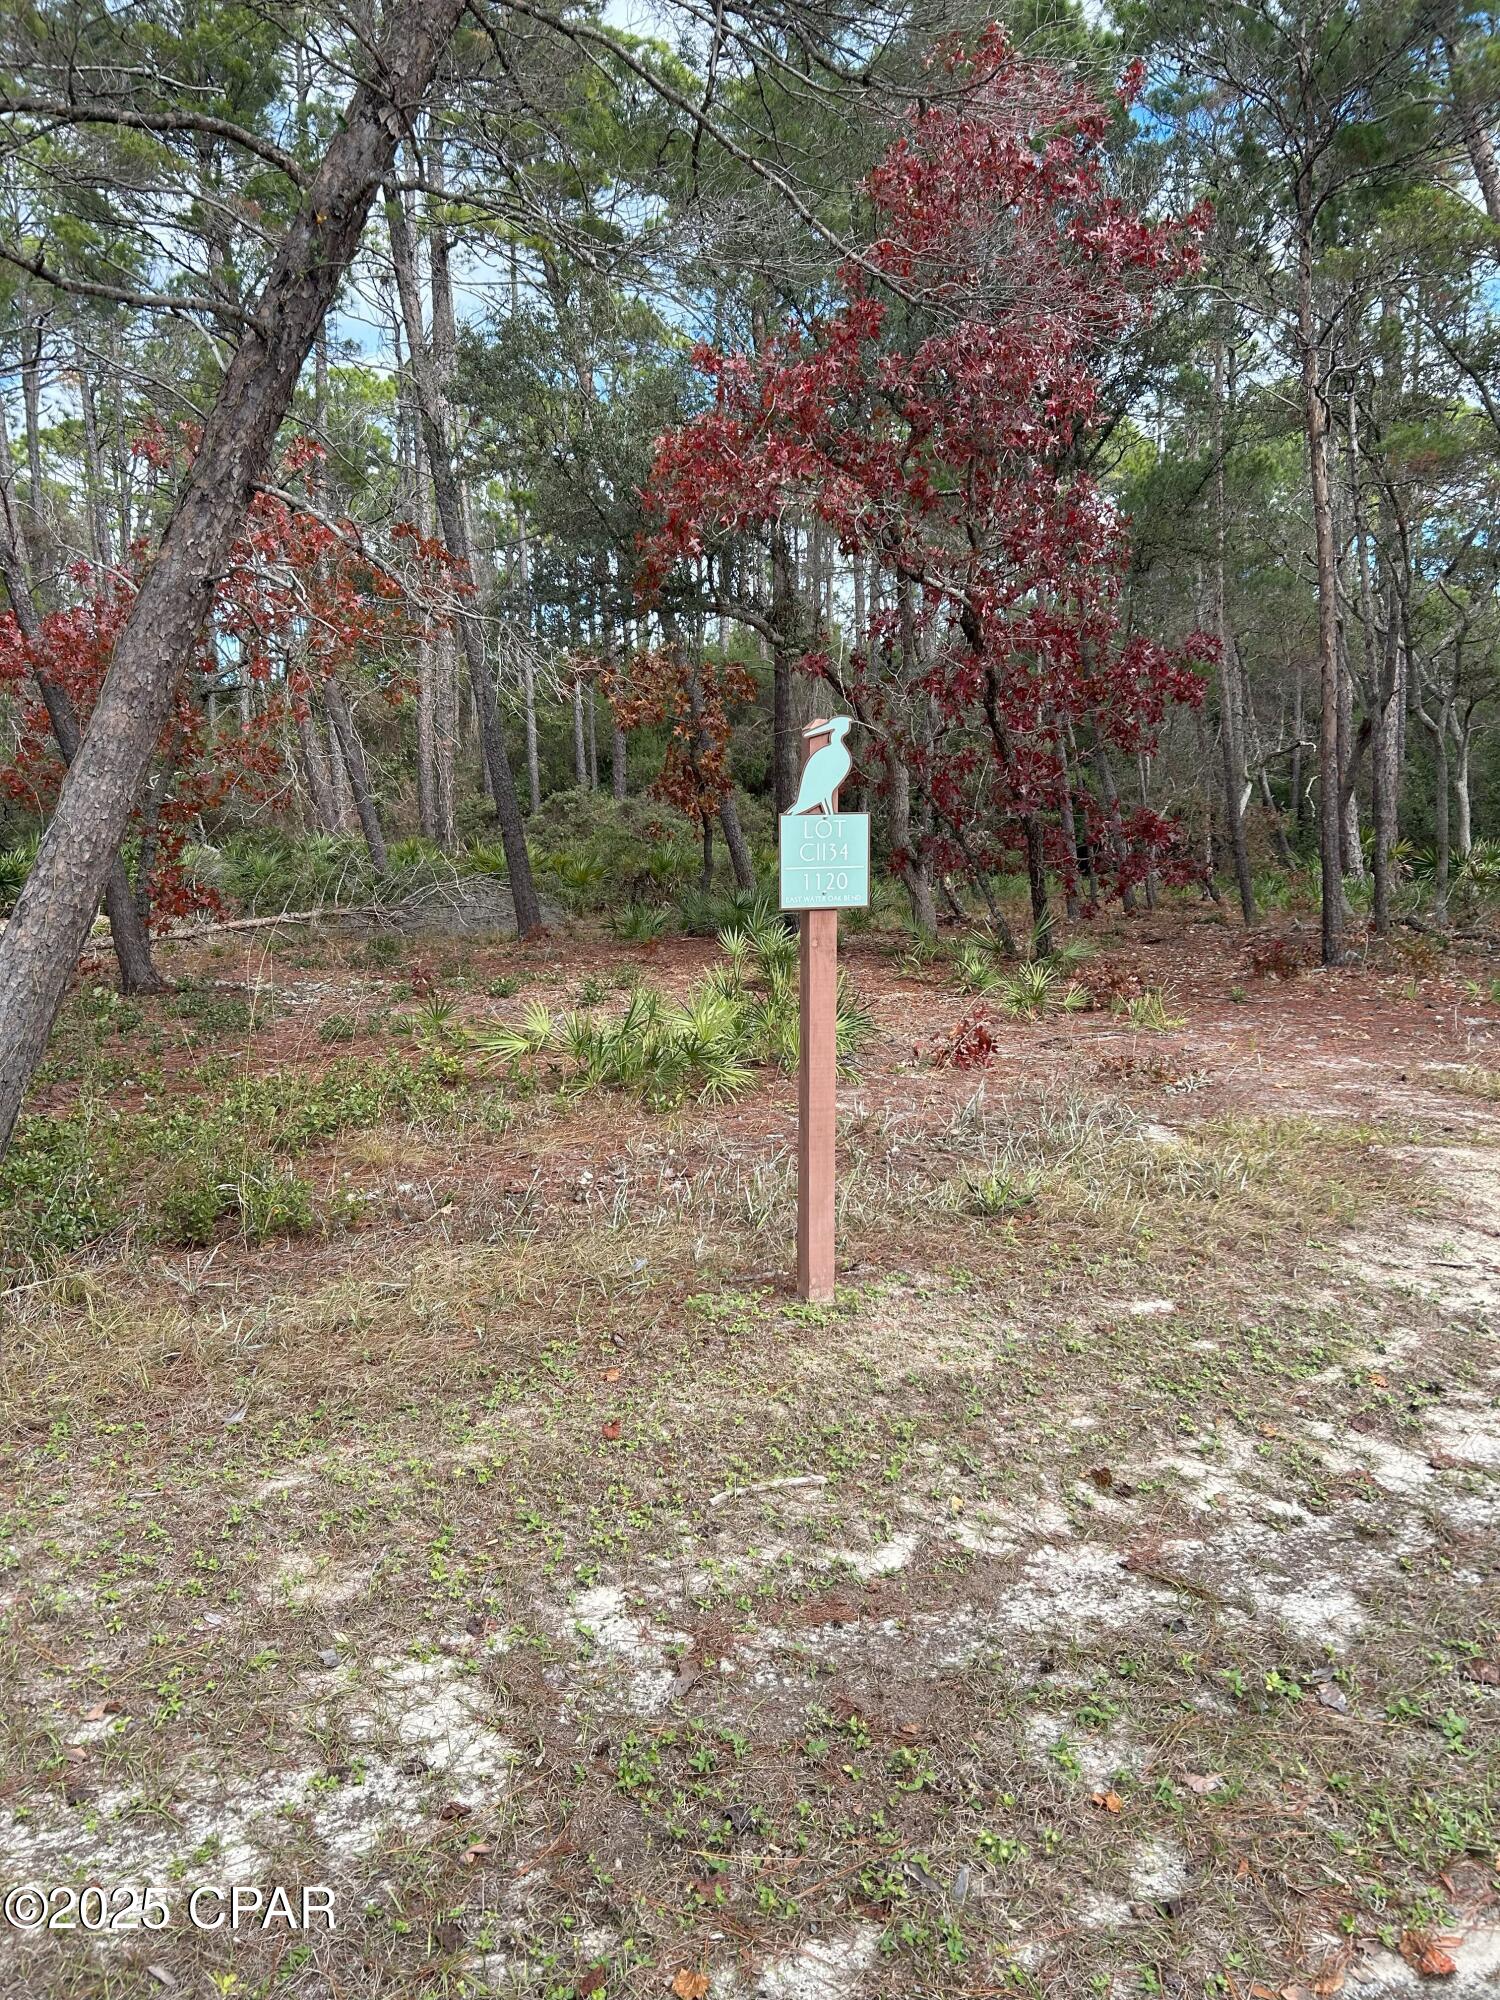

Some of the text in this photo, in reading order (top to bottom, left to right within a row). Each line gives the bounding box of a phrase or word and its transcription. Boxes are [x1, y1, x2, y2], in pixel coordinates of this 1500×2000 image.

[804, 819, 847, 838] LOT
[799, 842, 848, 862] C1134
[804, 872, 848, 890] 1120
[785, 896, 801, 904] EAST
